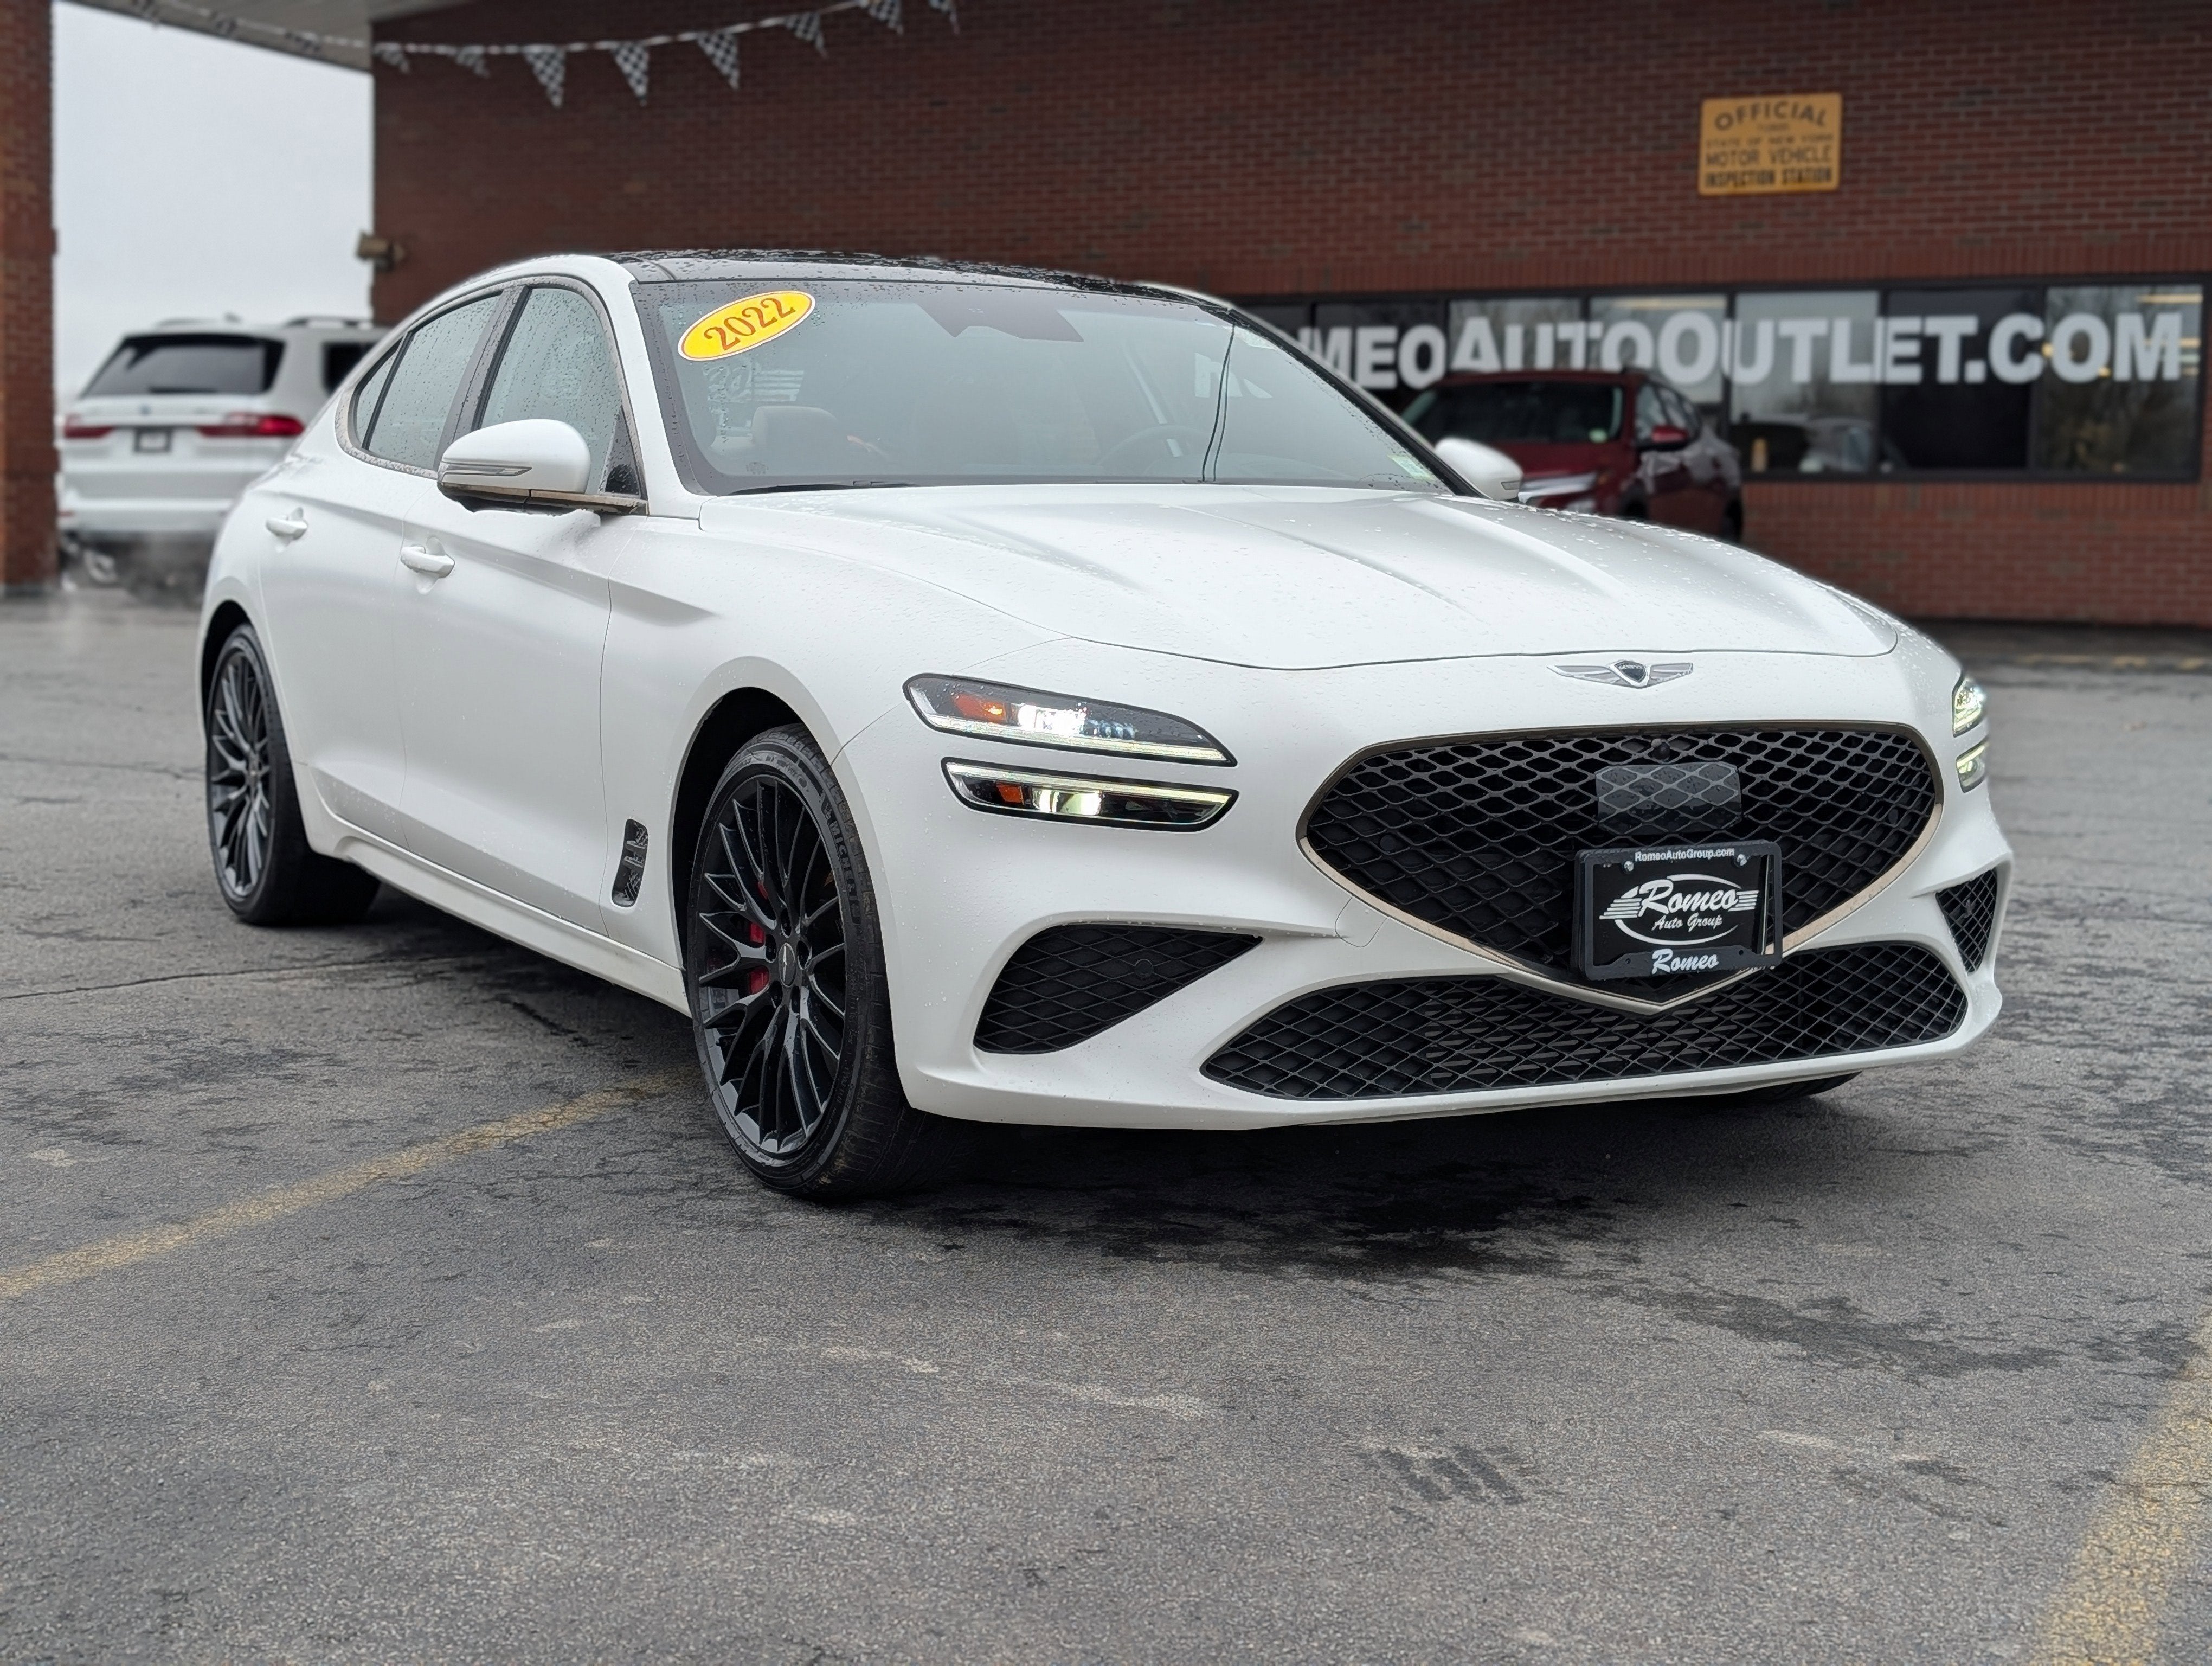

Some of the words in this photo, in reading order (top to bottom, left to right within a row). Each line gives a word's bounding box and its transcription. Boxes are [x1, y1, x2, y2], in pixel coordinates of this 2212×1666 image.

[1714, 100, 1827, 131] OFFICIAL
[703, 298, 796, 351] 2022
[1195, 309, 2183, 399] MEOAUTOOUTLET.COM
[1635, 848, 1735, 862] RomeoAutoGroup.com
[1638, 879, 1739, 917] Romeo
[1651, 914, 1683, 931] Auto
[1687, 912, 1723, 932] Group
[1651, 948, 1719, 975] Romeo
